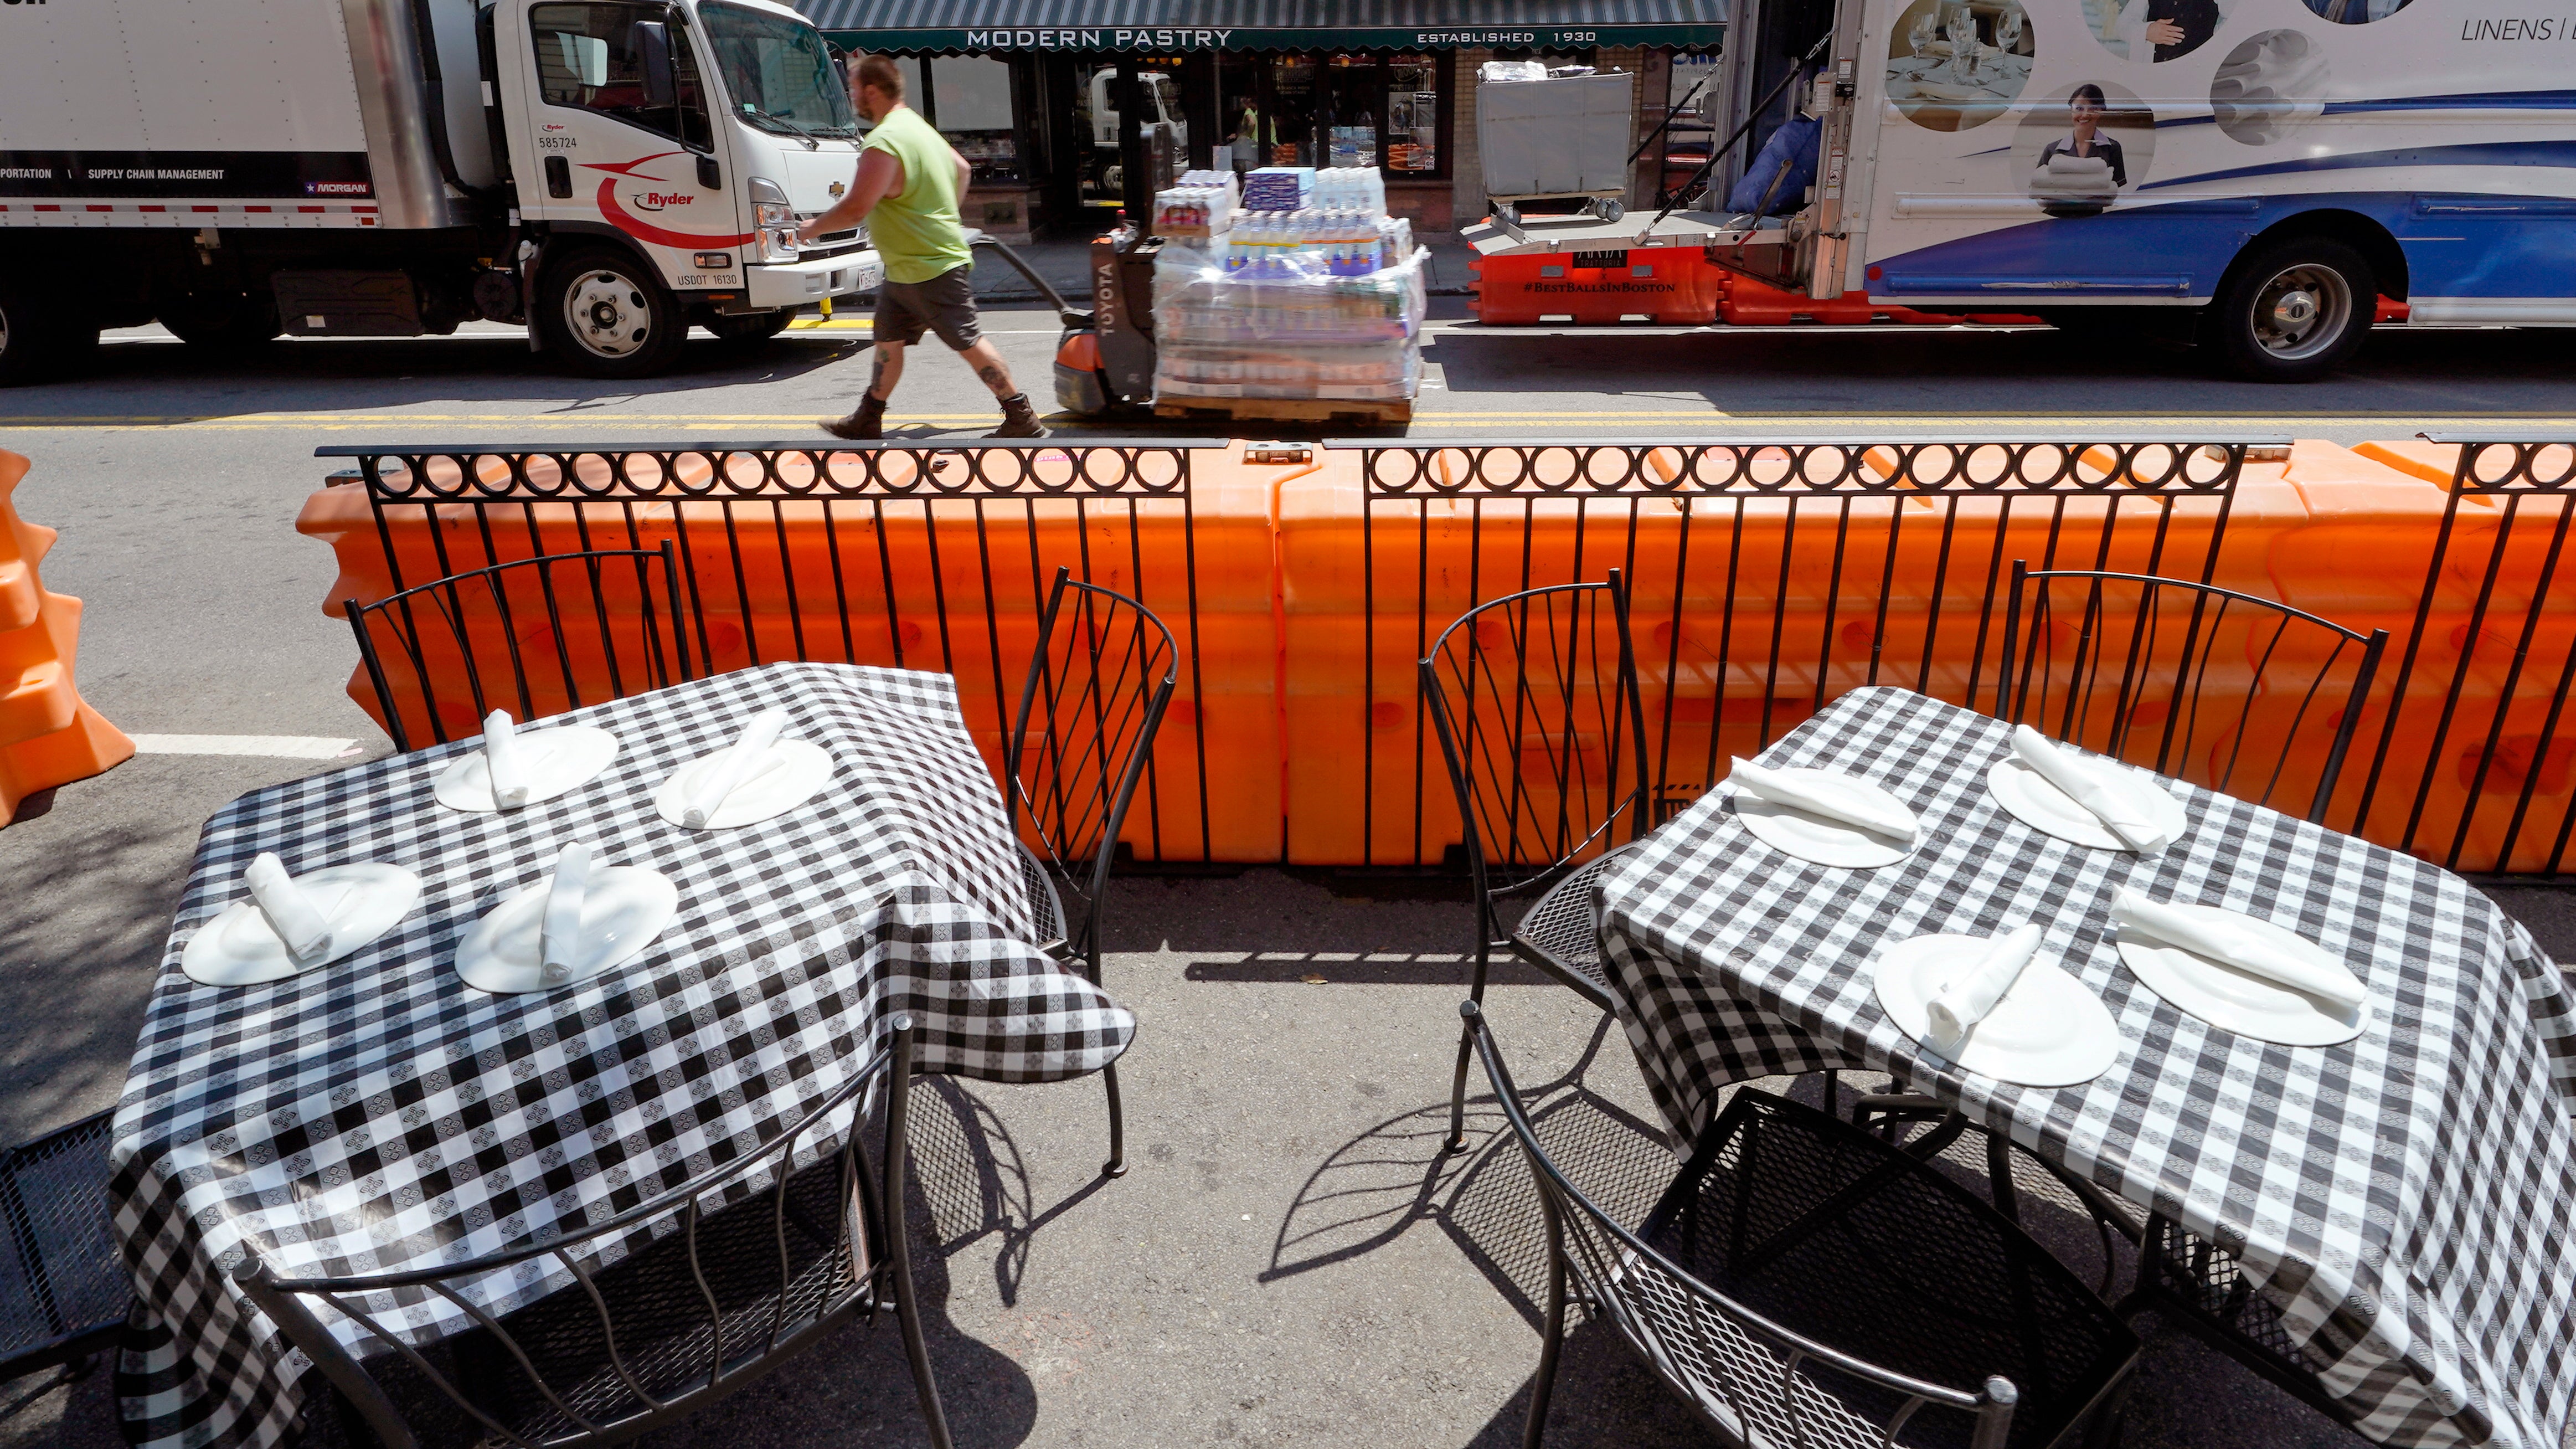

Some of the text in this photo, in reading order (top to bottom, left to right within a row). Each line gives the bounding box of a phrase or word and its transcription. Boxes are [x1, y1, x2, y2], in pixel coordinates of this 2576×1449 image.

[2462, 18, 2554, 40] LINENS
[967, 29, 1233, 47] MODERN PASTRY
[1417, 32, 1596, 43] ESTABLISHED 1930
[539, 137, 577, 148] 585724
[0, 168, 224, 179] PORTATION SUPPLY CHAIN MANAGEMENT
[317, 184, 367, 193] MORGAN
[647, 192, 694, 207] Ryder
[1580, 259, 1621, 268] TRATTORIA
[678, 275, 737, 285] USDOT 16130
[1098, 263, 1115, 337] TOYOTA
